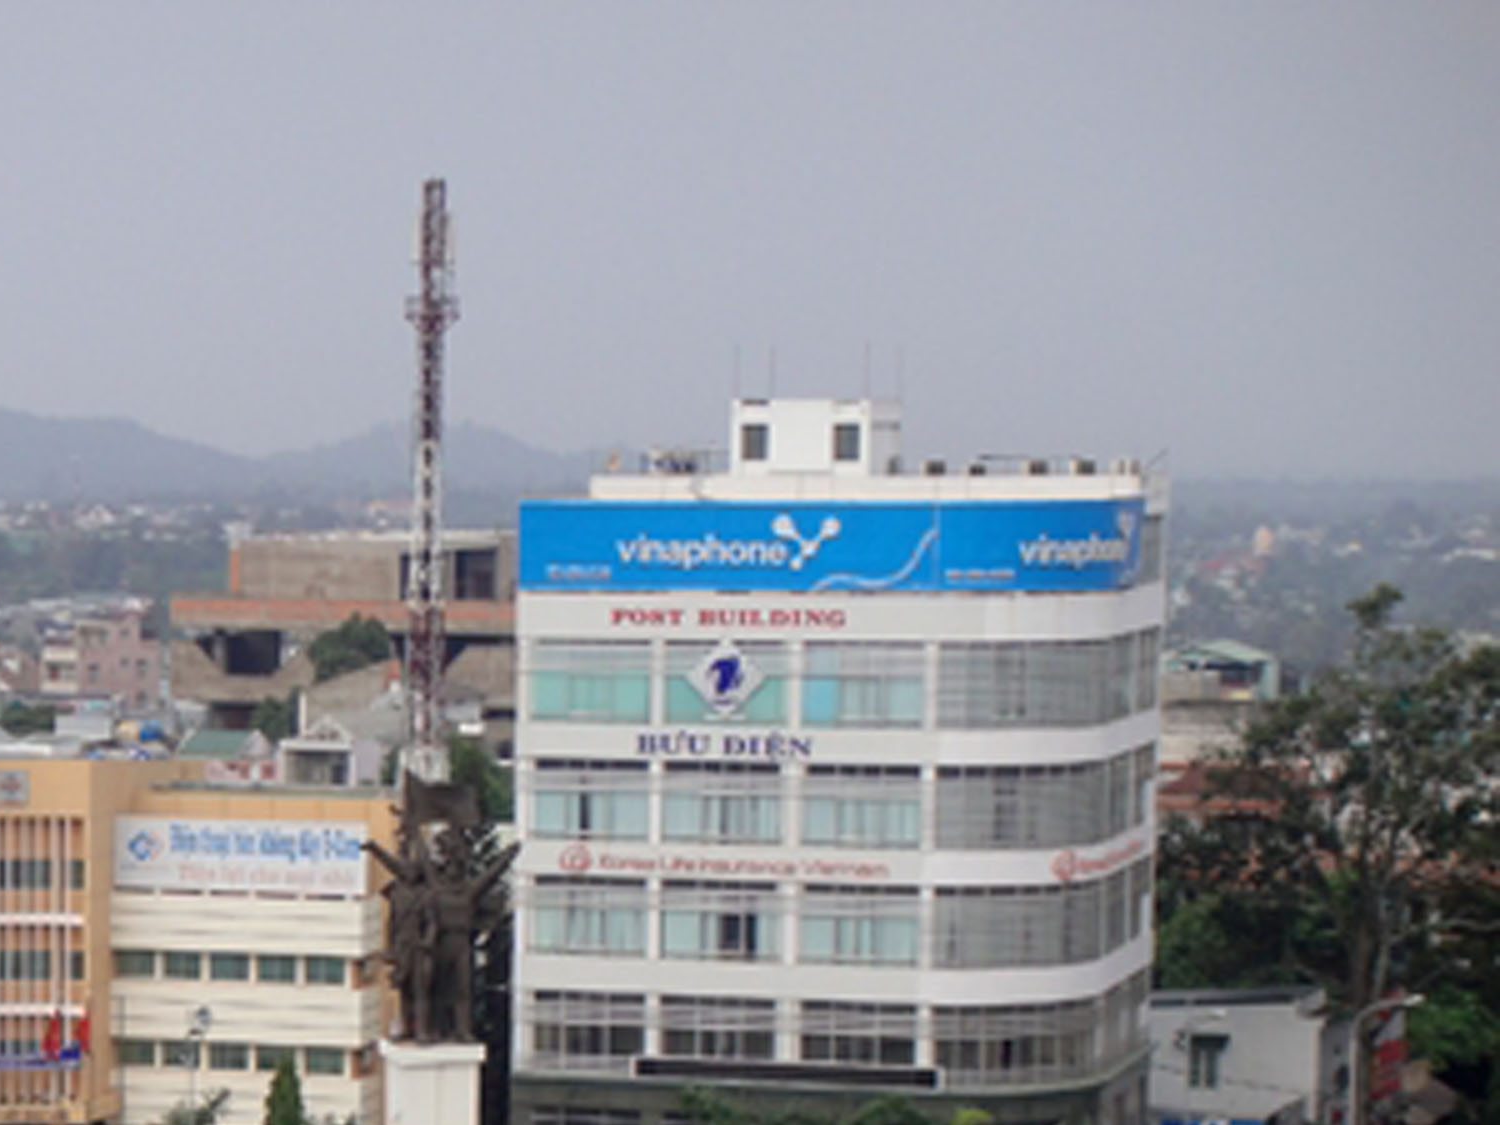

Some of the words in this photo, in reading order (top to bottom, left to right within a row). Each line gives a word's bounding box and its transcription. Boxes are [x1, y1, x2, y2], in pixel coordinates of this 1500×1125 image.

[616, 533, 787, 569] vinaphone
[610, 608, 682, 627] POST
[698, 609, 846, 628] BUILDING
